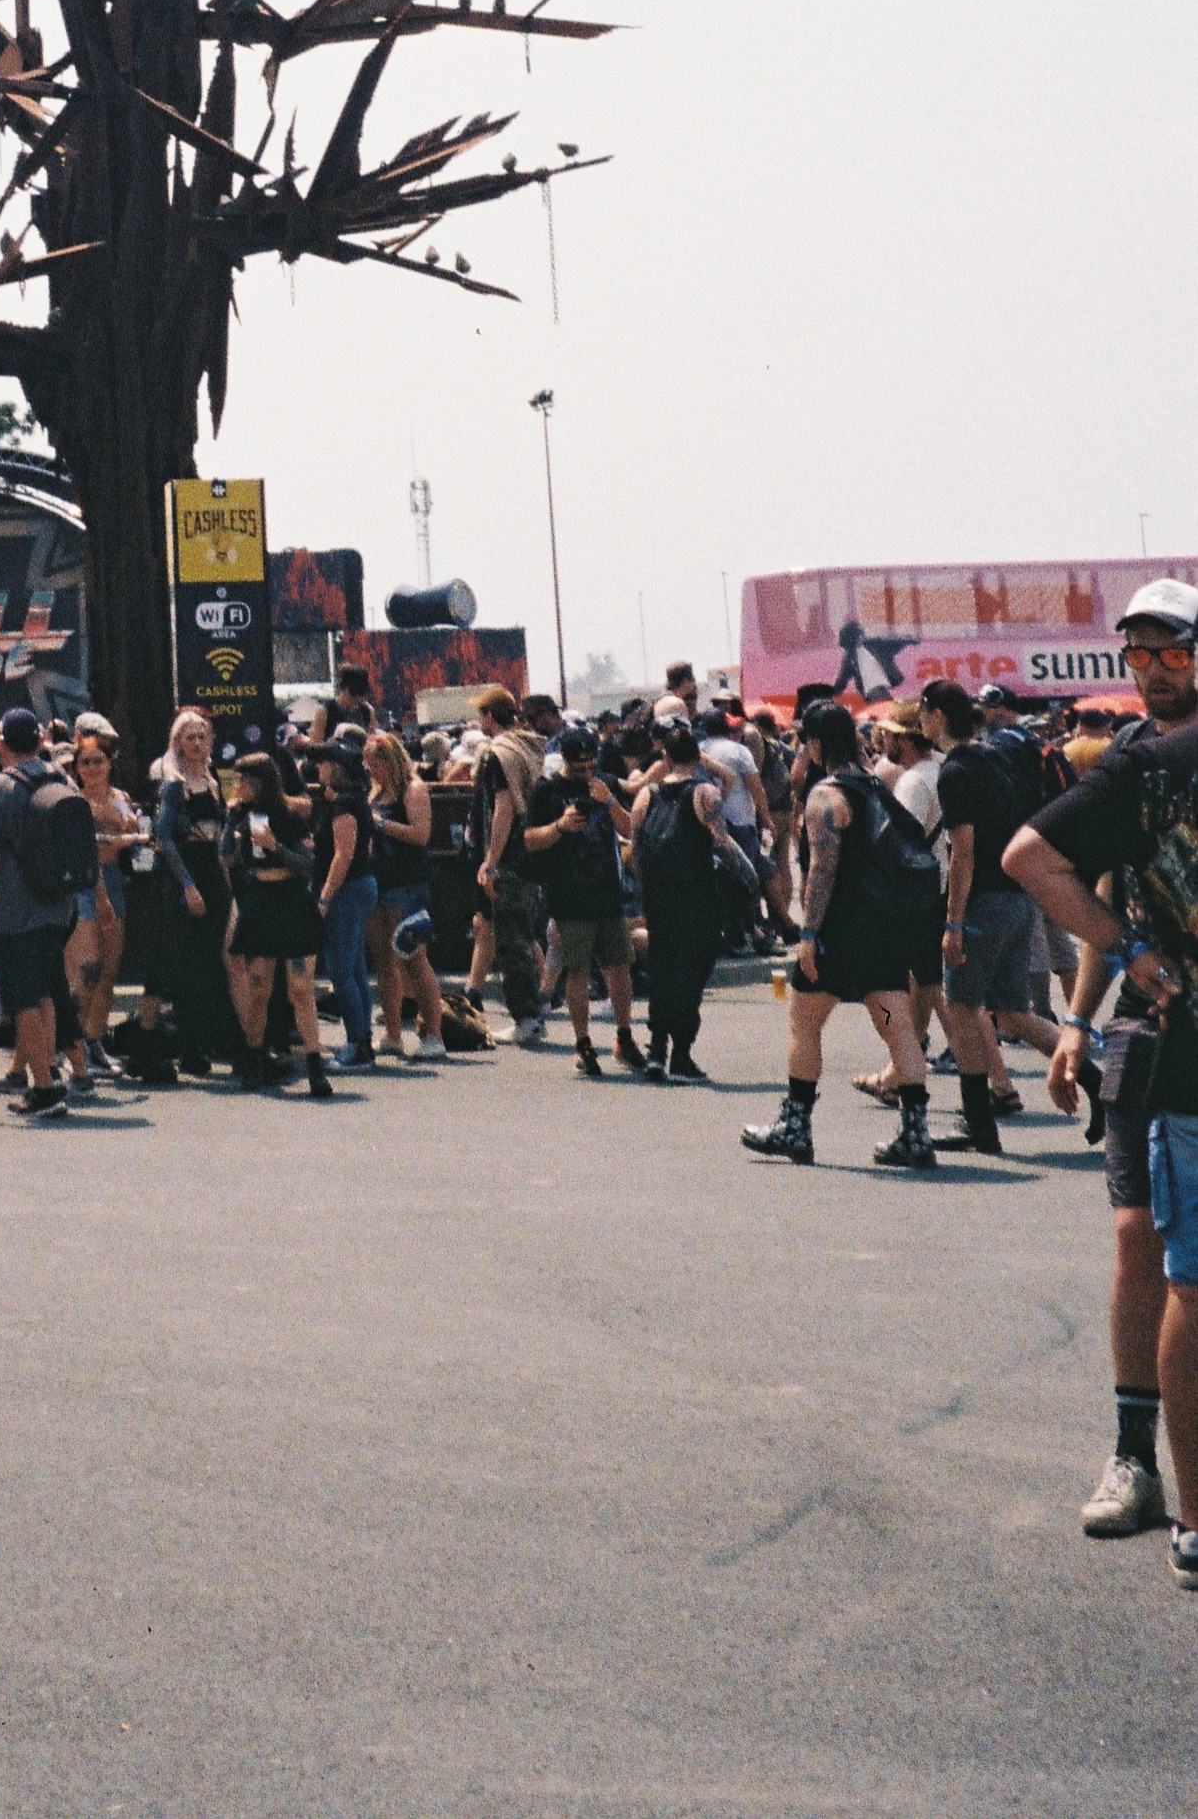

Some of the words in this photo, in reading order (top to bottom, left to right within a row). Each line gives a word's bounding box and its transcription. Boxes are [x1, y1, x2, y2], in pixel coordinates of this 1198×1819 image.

[183, 509, 257, 539] CASHLESS
[916, 652, 1017, 679] arte
[197, 685, 256, 696] CASHLESS
[212, 704, 242, 716] SPOT
